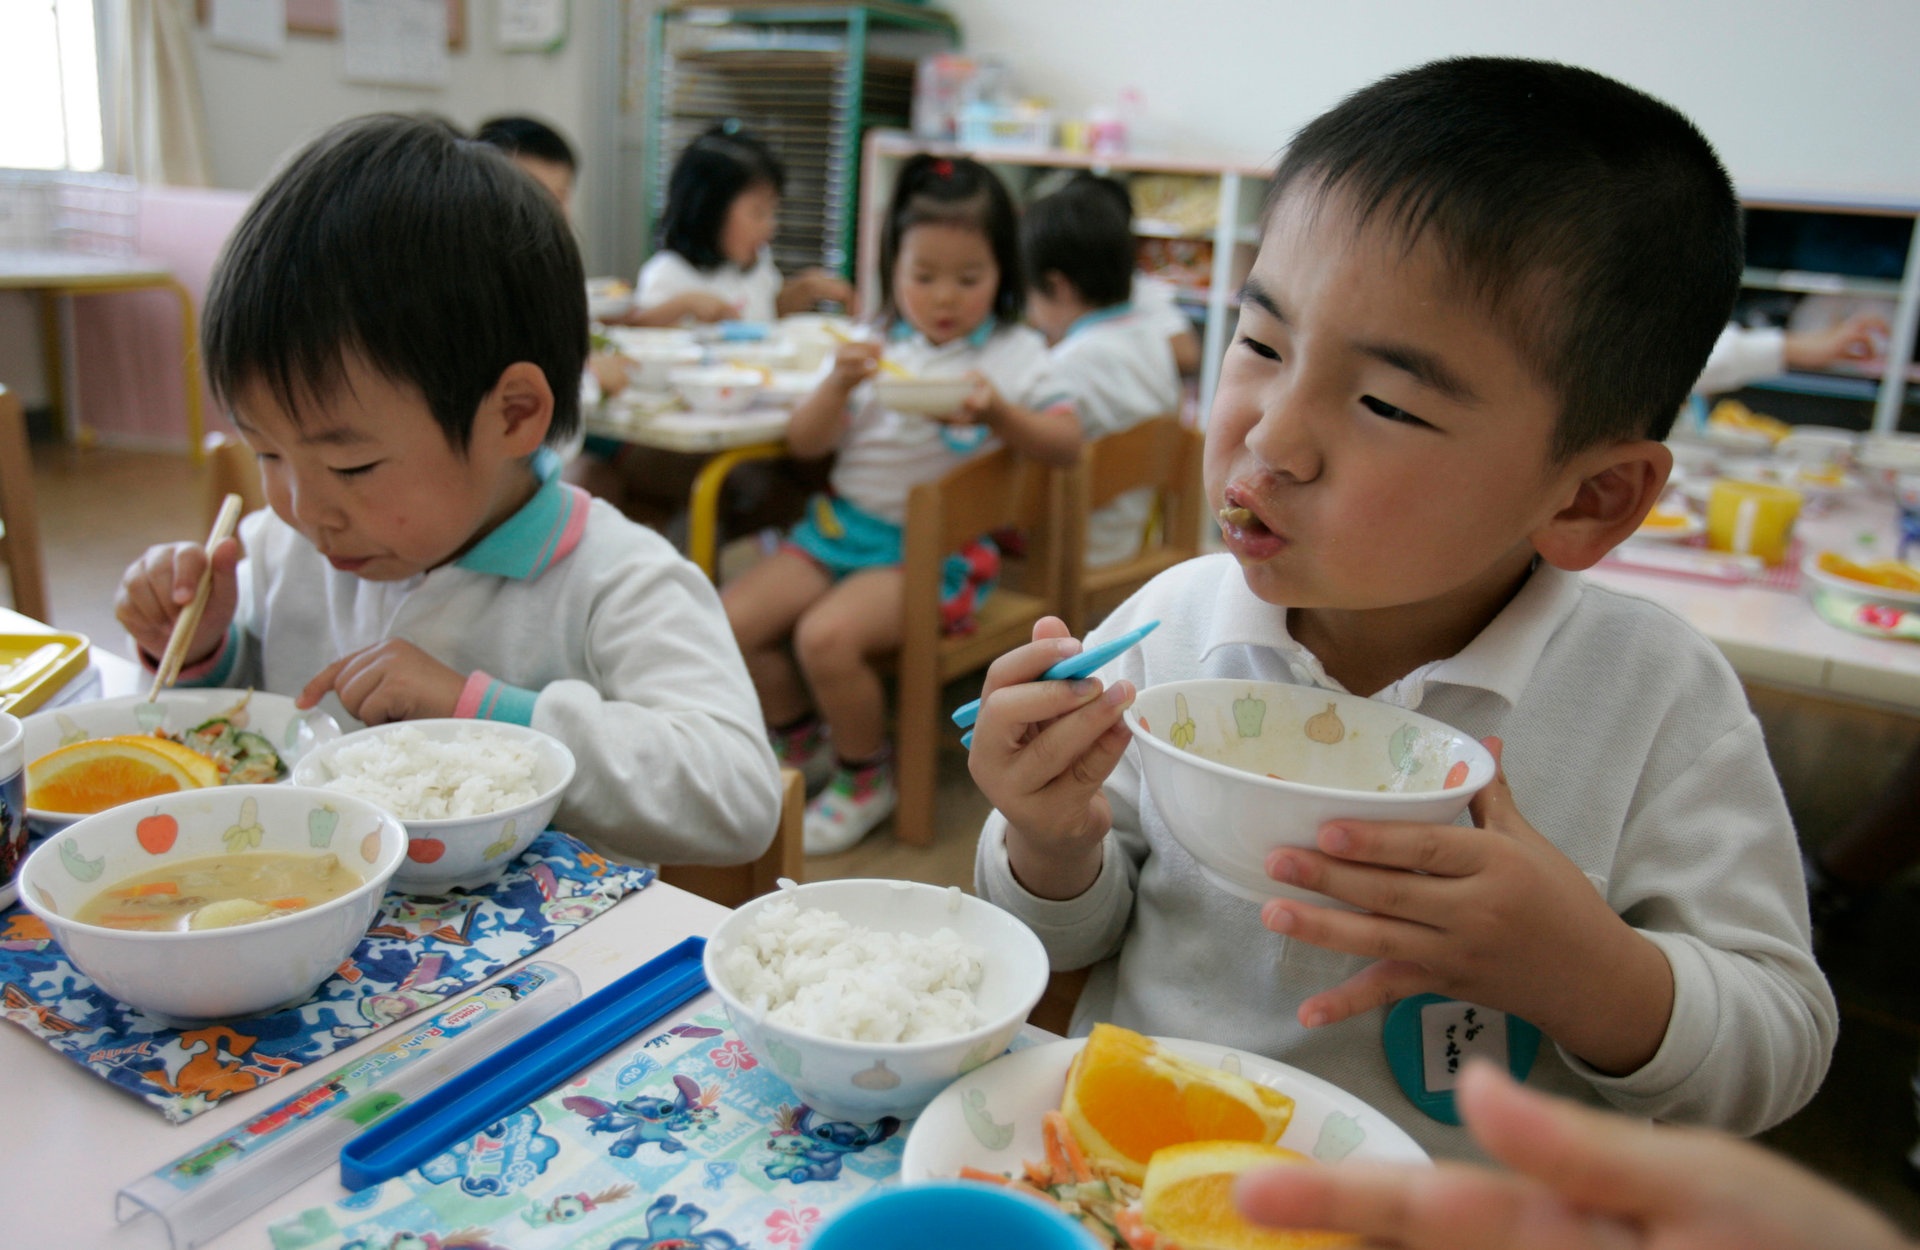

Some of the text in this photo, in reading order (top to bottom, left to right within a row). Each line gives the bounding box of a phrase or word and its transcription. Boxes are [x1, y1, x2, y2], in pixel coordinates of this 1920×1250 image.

[448, 1005, 483, 1025] THOMAS
[401, 1028, 443, 1049] Right
[351, 1059, 387, 1078] Time
